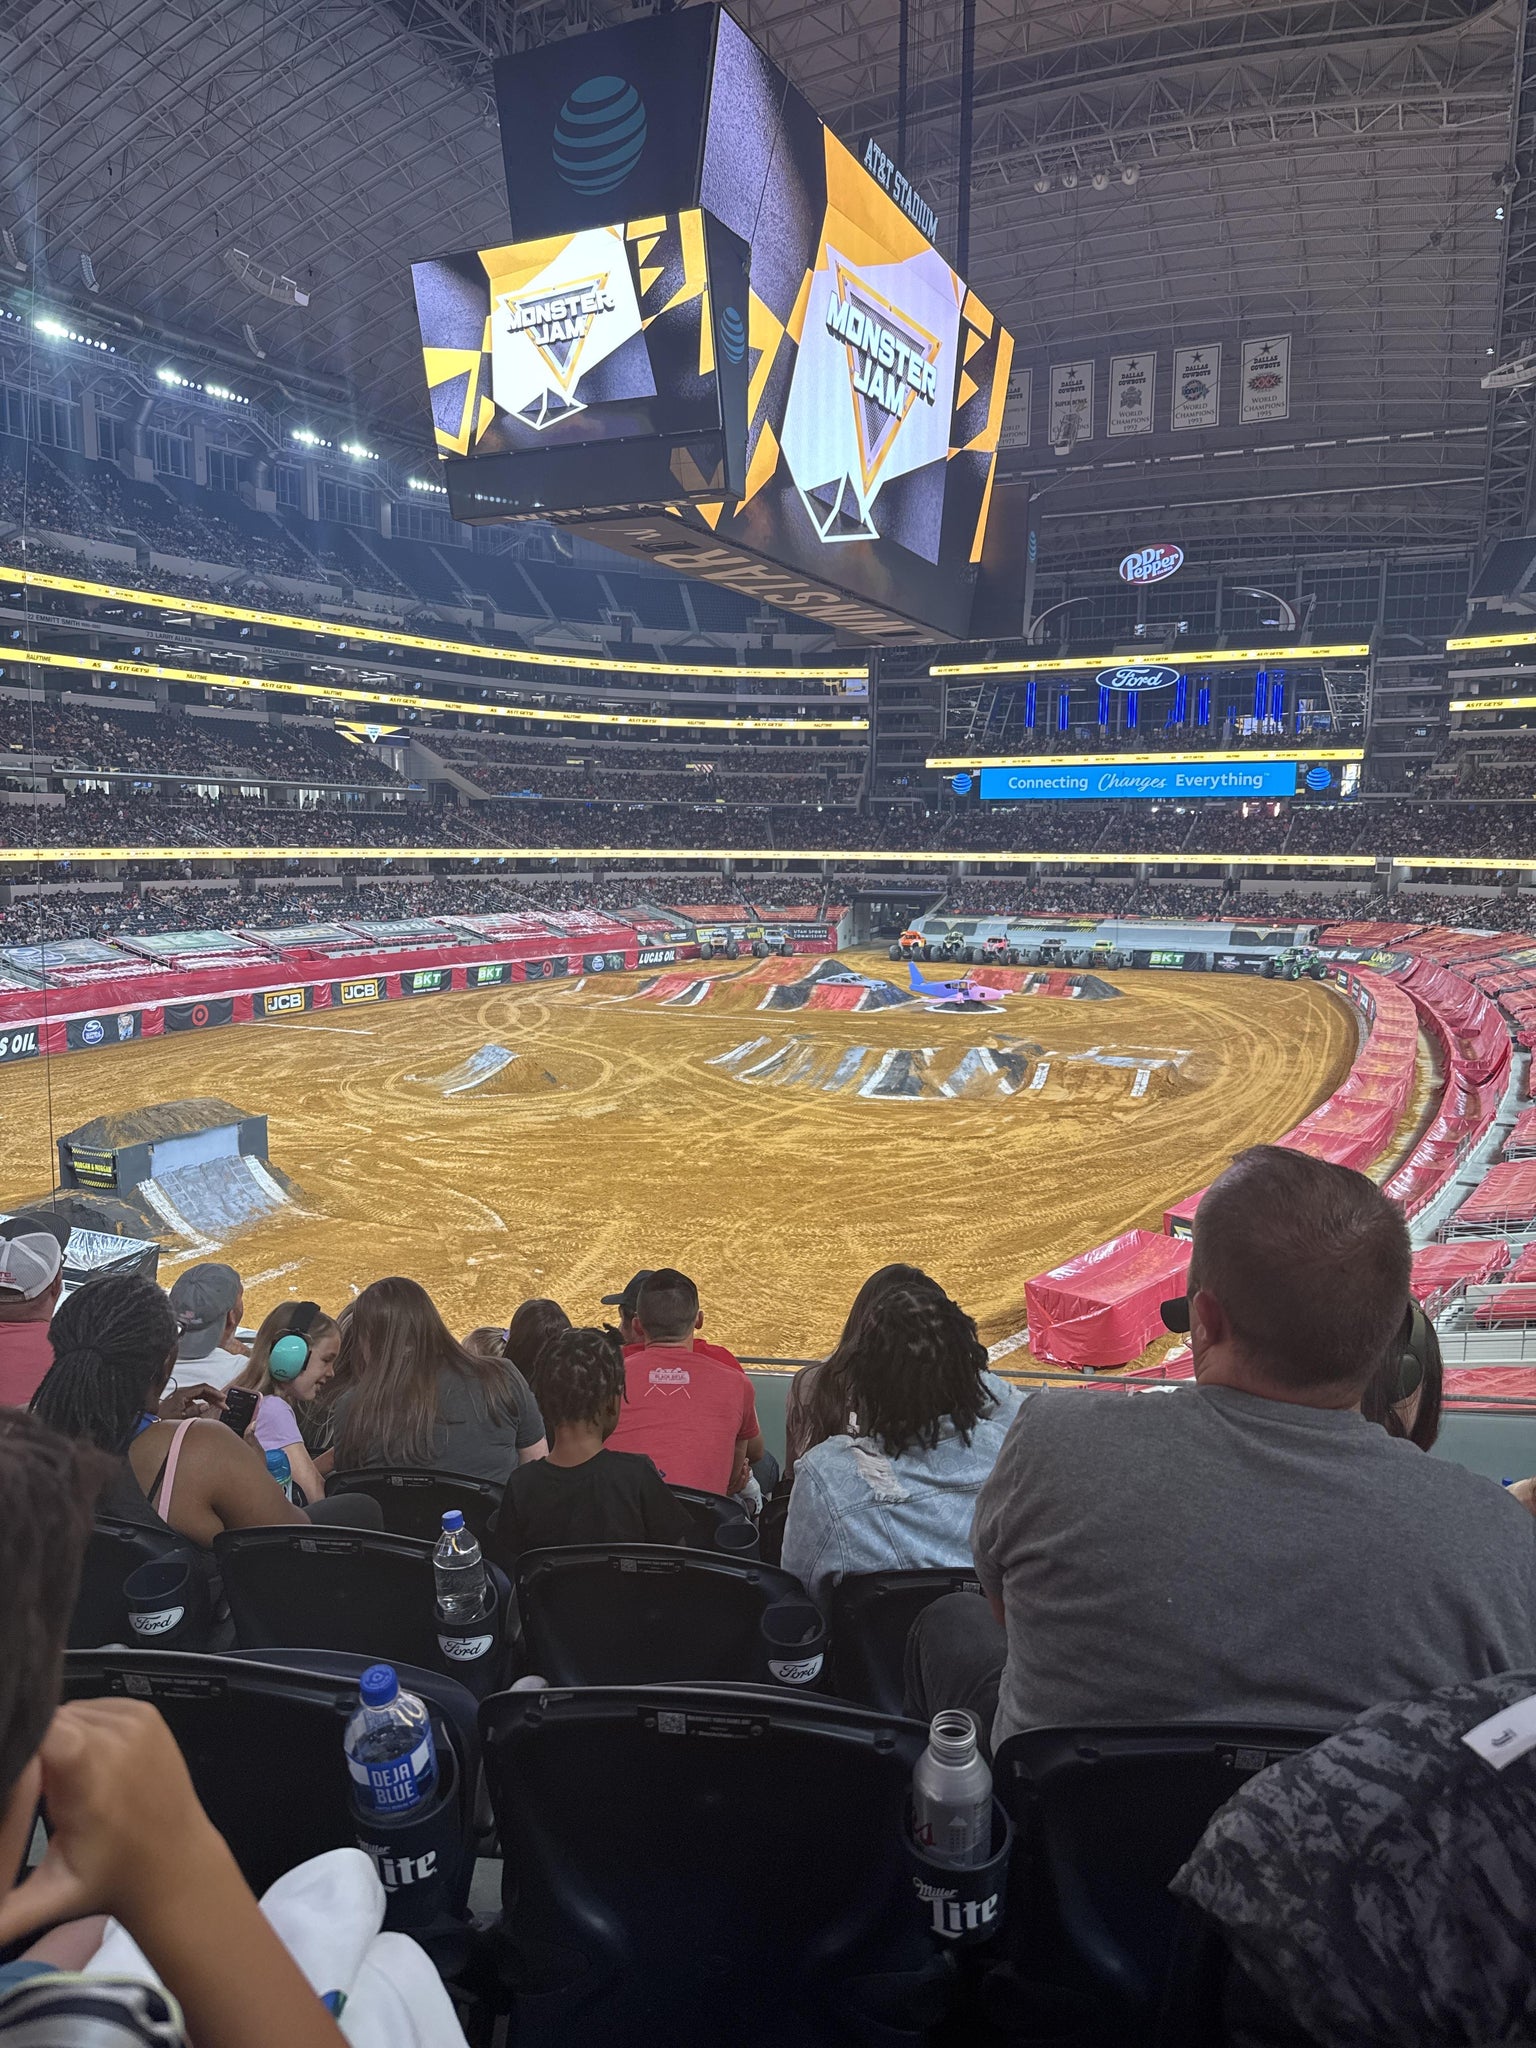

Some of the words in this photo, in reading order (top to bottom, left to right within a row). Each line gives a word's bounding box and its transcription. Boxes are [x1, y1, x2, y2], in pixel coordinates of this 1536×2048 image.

[864, 138, 894, 190] AT&T
[893, 170, 938, 243] STADIUM
[507, 290, 615, 333] MONSTER
[534, 317, 586, 346] JAM
[826, 290, 937, 406] MONSTER
[1250, 362, 1280, 371] COWBOYS
[1254, 356, 1278, 364] DALLAS
[1118, 378, 1146, 386] COWBOYS
[1182, 370, 1211, 378] COWBOYS
[853, 358, 906, 421] JAM
[1244, 401, 1285, 412] CHAMPIONS
[1252, 396, 1278, 404] WORLD
[1112, 416, 1150, 425] CHAMPIONS
[1176, 409, 1215, 419] CHAMPIONS
[503, 500, 695, 521] WINSTAR
[1142, 548, 1165, 566] Dr
[1126, 554, 1178, 581] Pepper
[653, 548, 918, 634] WINSTAR
[36, 615, 60, 624] EMMITT
[61, 618, 80, 627] SMITH
[1111, 668, 1164, 688] Ford
[1008, 776, 1088, 791] Connecting
[1098, 773, 1167, 792] Changes
[639, 951, 662, 964] LUCAS
[664, 950, 675, 961] OIL
[1151, 953, 1185, 963] BKT
[415, 974, 440, 985] BKT
[478, 968, 502, 978] BKT
[345, 984, 375, 999] JCB
[268, 994, 301, 1010] JCB
[12, 1032, 36, 1054] OIL
[134, 1616, 172, 1631] Ford
[444, 1639, 482, 1656] Ford
[779, 1662, 818, 1680] Ford
[372, 1763, 411, 1787] DEJA
[376, 1781, 415, 1804] BLUE
[912, 1876, 958, 1901] Miller
[930, 1893, 998, 1939] Lite
